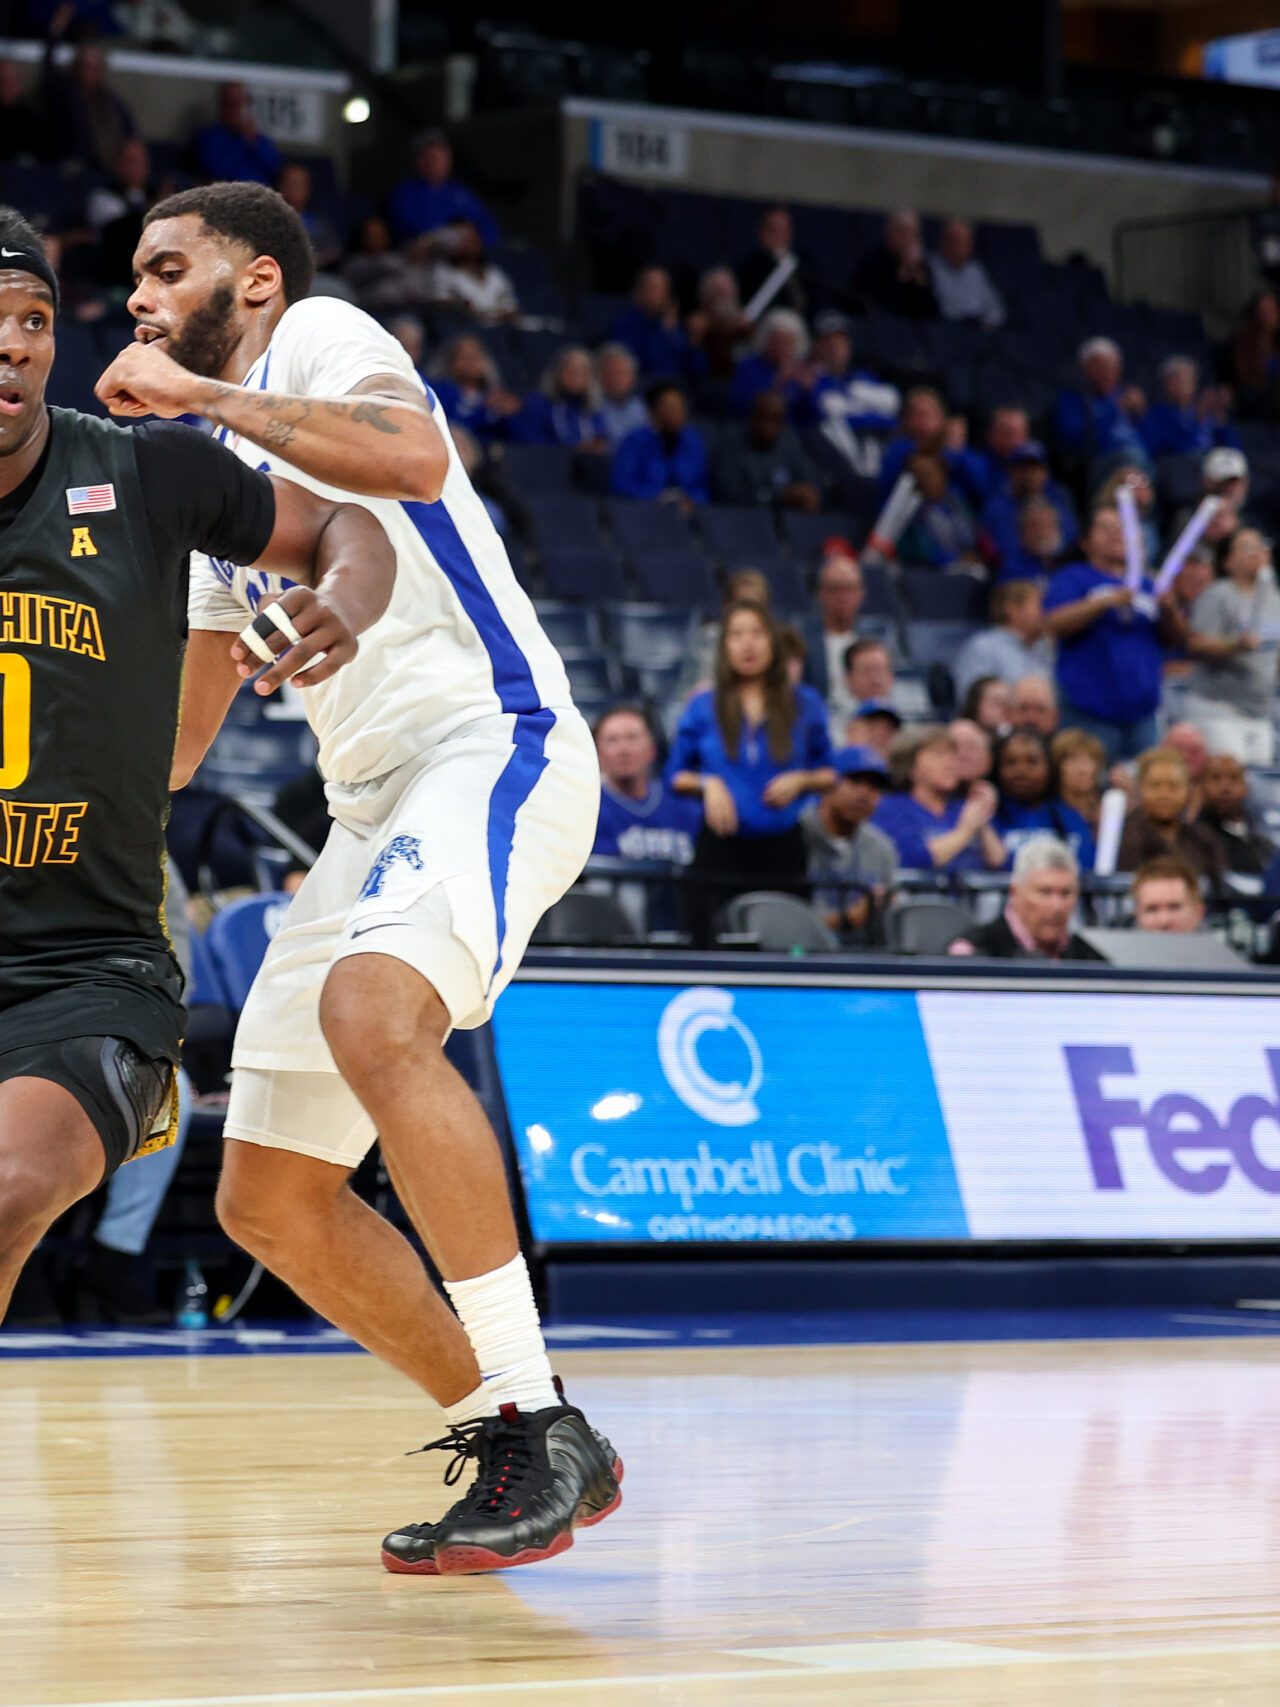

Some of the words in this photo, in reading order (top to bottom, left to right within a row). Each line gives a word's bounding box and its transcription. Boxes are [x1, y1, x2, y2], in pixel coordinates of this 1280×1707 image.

[70, 526, 98, 556] A
[571, 1140, 782, 1211] Campbell
[787, 1140, 911, 1196] Clinic
[647, 1213, 857, 1242] ORTHOPAEDICS
